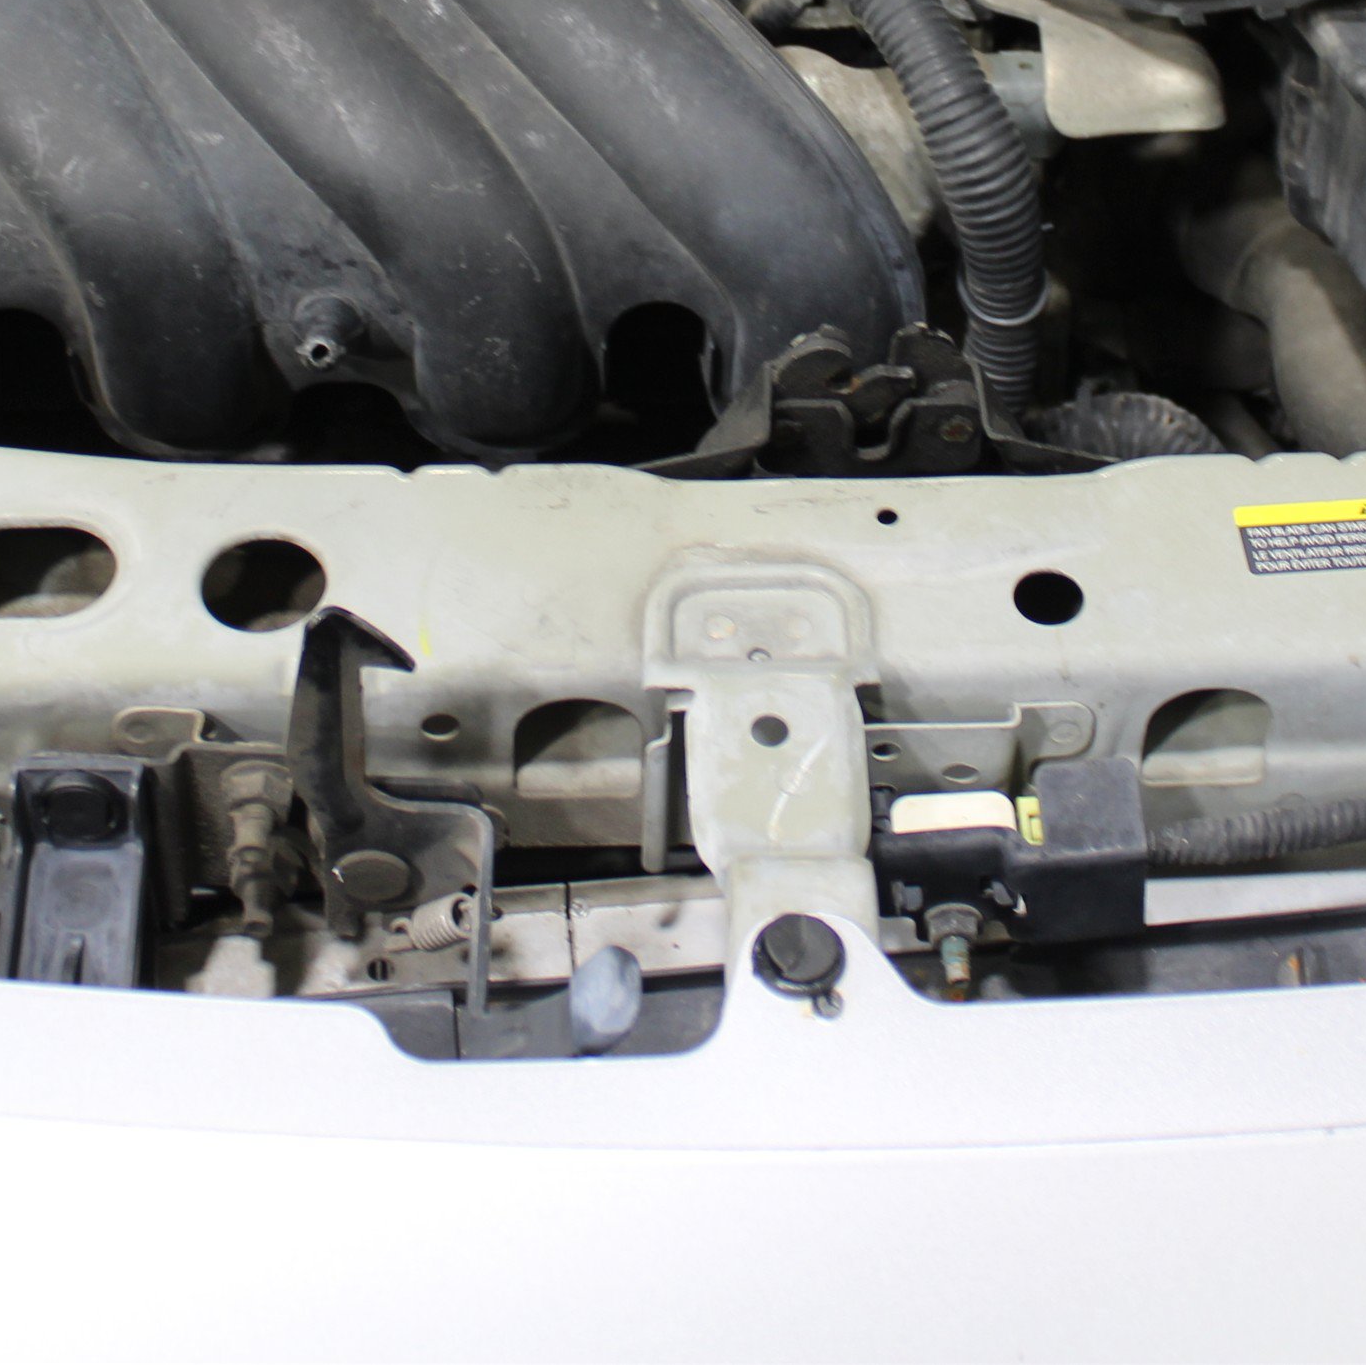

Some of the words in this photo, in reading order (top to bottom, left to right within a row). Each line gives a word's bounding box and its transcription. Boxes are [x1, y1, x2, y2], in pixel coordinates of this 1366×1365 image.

[1246, 526, 1272, 538] FAN
[1270, 523, 1311, 537] BLADE
[1309, 521, 1338, 535] CAN
[1248, 537, 1268, 549] TO
[1266, 535, 1300, 548] HELP
[1299, 533, 1337, 547] AVOID
[1252, 549, 1270, 561] LE
[1267, 544, 1344, 560] VENTILATEUR
[1255, 558, 1292, 572] POUR
